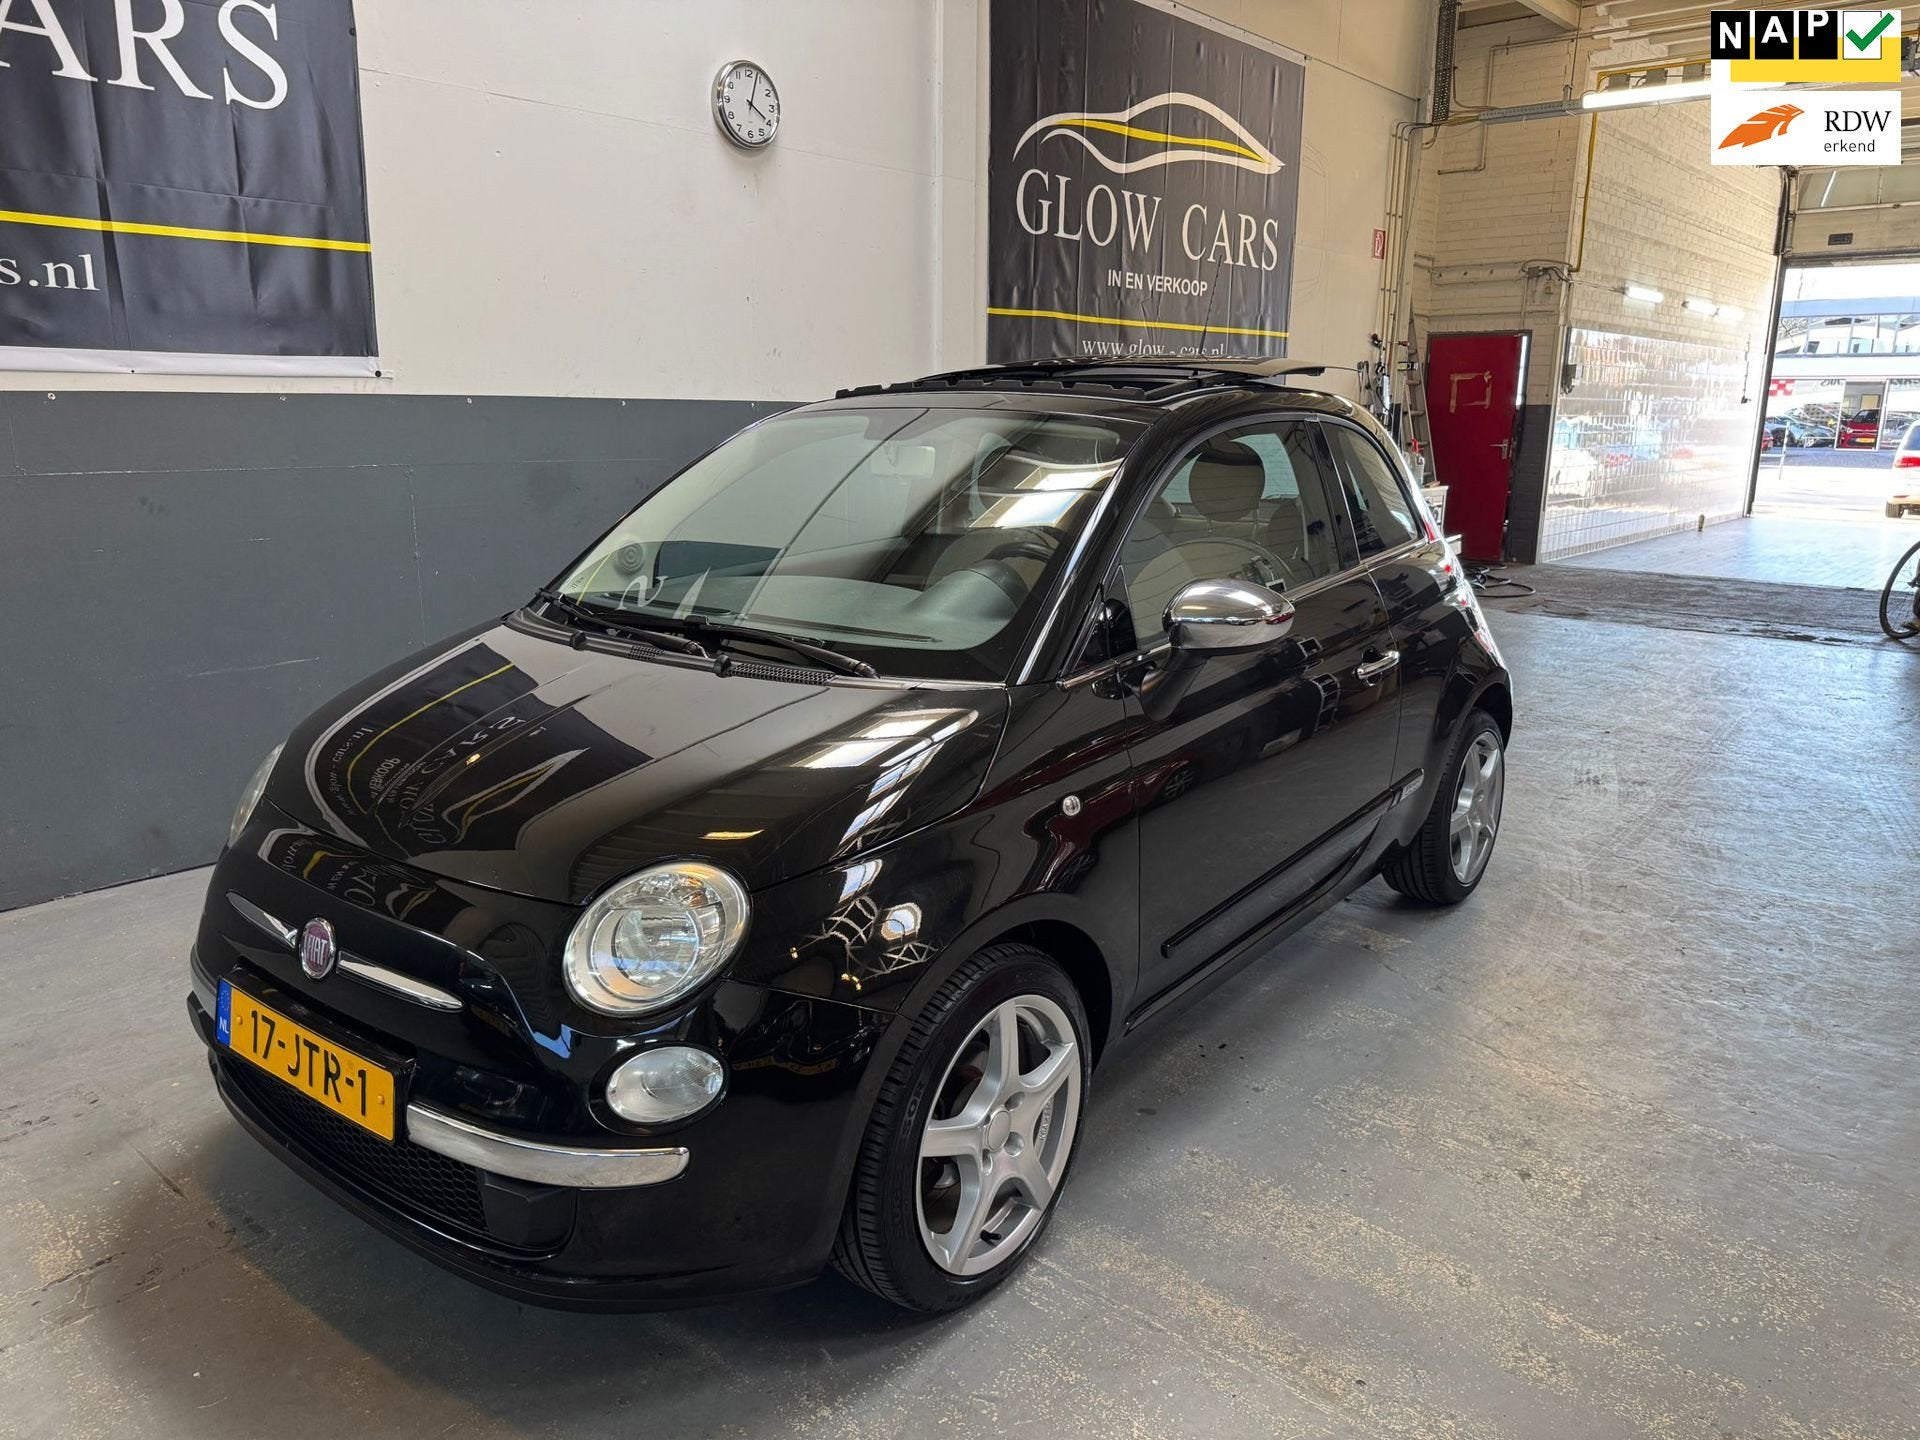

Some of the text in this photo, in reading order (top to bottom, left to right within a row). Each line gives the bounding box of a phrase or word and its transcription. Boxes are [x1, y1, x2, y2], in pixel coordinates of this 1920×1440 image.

[765, 89, 771, 97] 2
[724, 95, 730, 103] 9
[769, 105, 775, 113] 3
[728, 111, 734, 119] 8
[766, 119, 772, 127] 4
[737, 124, 742, 132] 7
[759, 128, 765, 136] 5
[748, 130, 754, 138] 6
[1015, 168, 1279, 271] GLOW CARS
[1107, 269, 1208, 297] IN EN VERKOOP
[304, 933, 328, 965] FIAT
[219, 1016, 229, 1034] NL
[251, 1009, 367, 1117] 17-JTR-1
